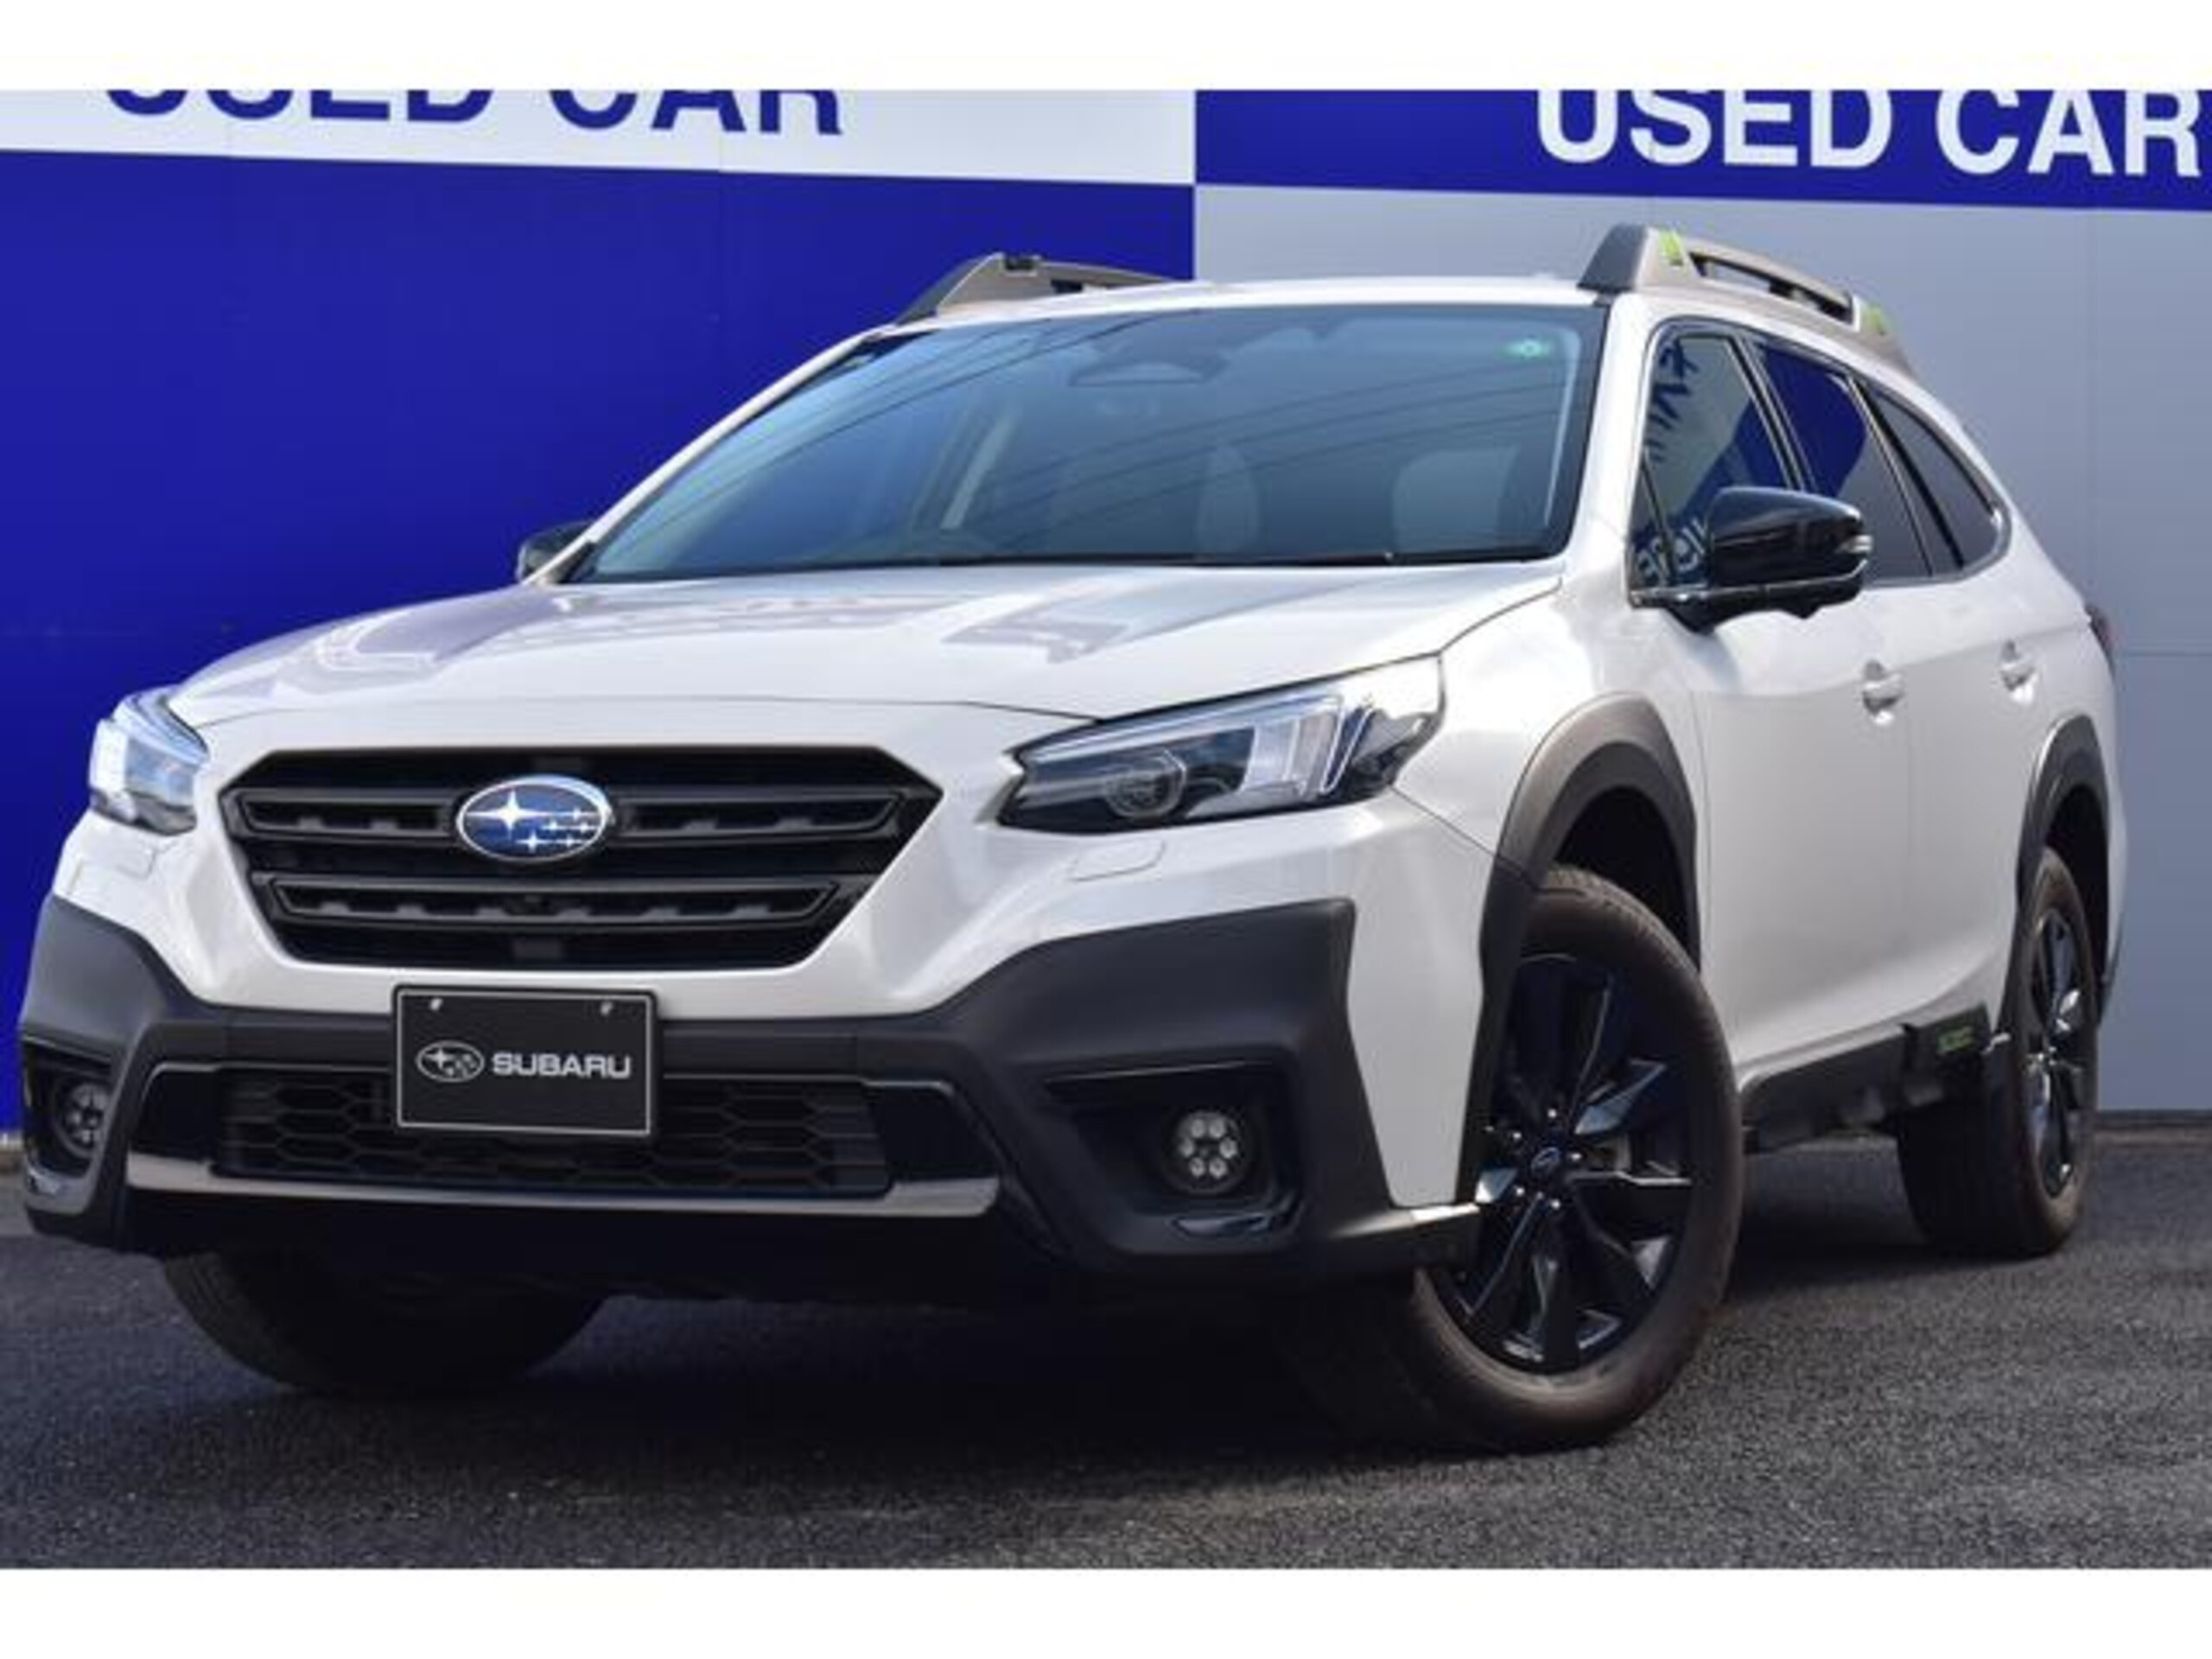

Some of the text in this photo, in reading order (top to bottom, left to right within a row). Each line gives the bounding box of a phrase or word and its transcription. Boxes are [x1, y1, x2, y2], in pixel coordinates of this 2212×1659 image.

[1537, 90, 2202, 177] USED CAR
[492, 1052, 631, 1078] SUBARU
